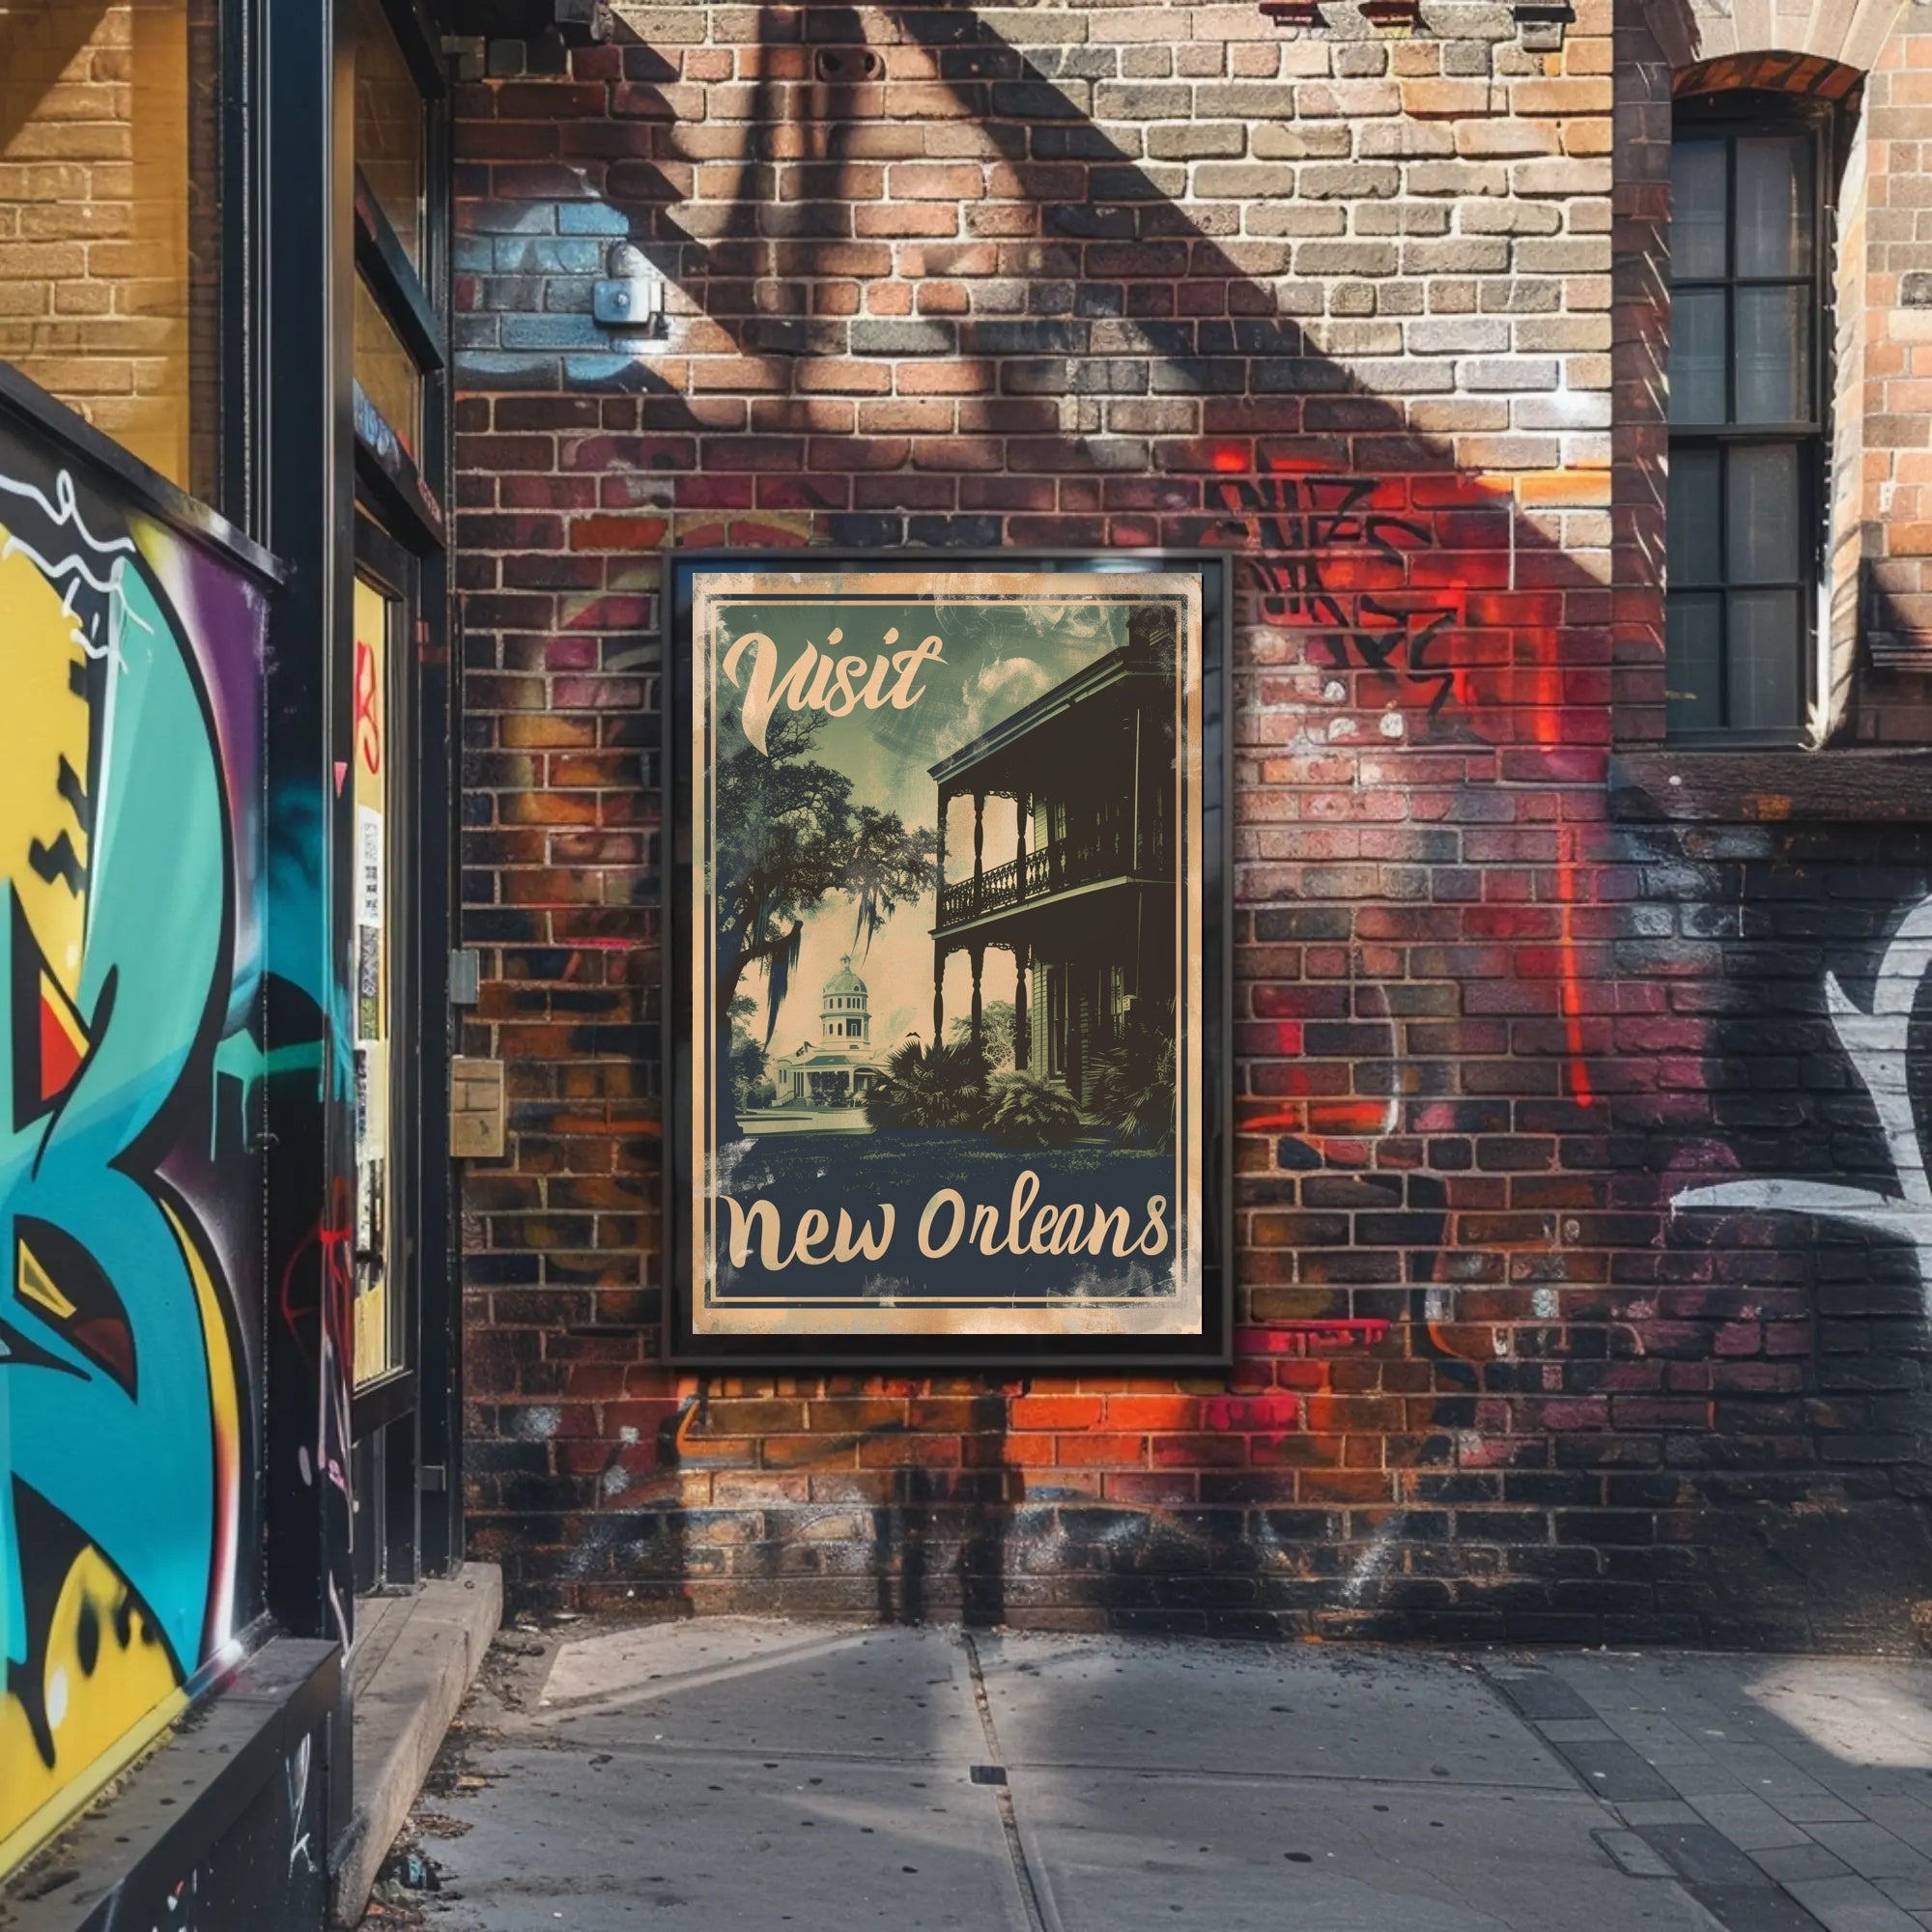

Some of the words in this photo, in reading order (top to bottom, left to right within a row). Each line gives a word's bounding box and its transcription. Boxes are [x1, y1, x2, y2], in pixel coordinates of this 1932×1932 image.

[723, 627, 949, 756] Visit
[720, 1195, 895, 1270] New
[918, 1170, 1168, 1259] Orleans
